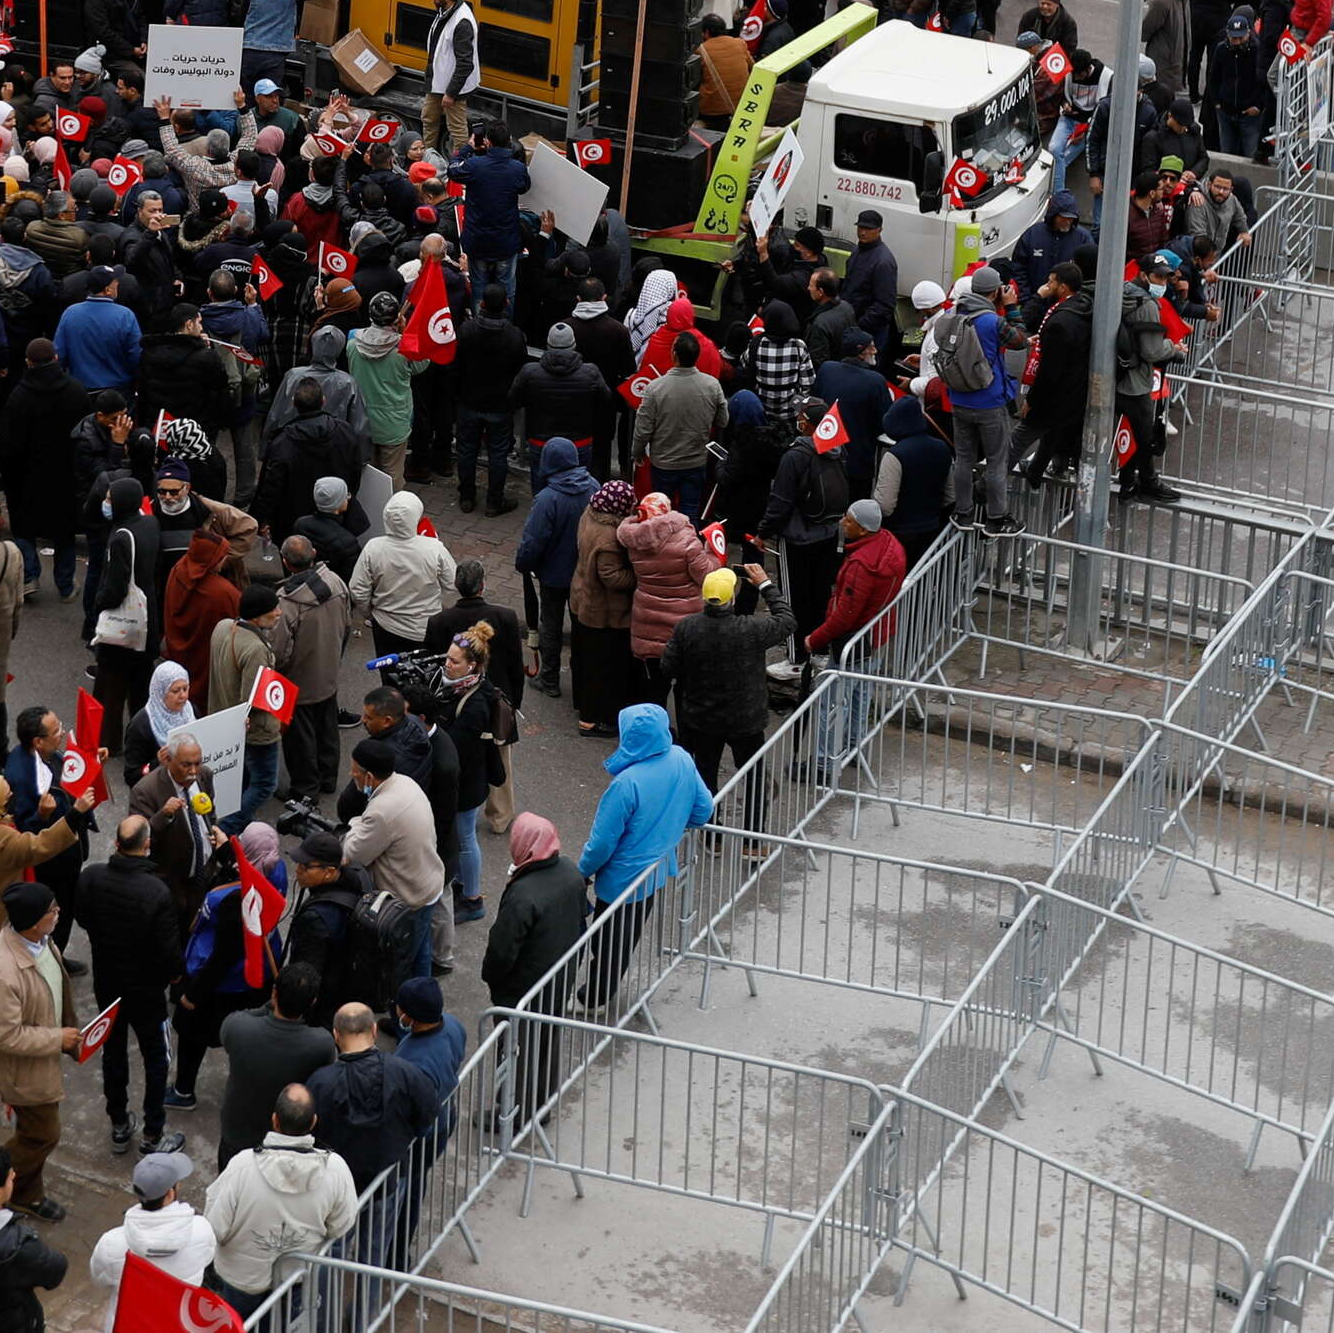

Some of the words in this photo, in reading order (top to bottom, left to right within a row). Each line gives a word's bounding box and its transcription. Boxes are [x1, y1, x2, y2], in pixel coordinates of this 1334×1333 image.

[171, 53, 198, 64] حريات
[200, 54, 226, 65] حريات
[152, 65, 176, 76] وفات
[177, 67, 212, 78] البوليس
[214, 68, 235, 78] دولة
[836, 176, 902, 201] 22.880.742
[213, 759, 238, 775] المساج
